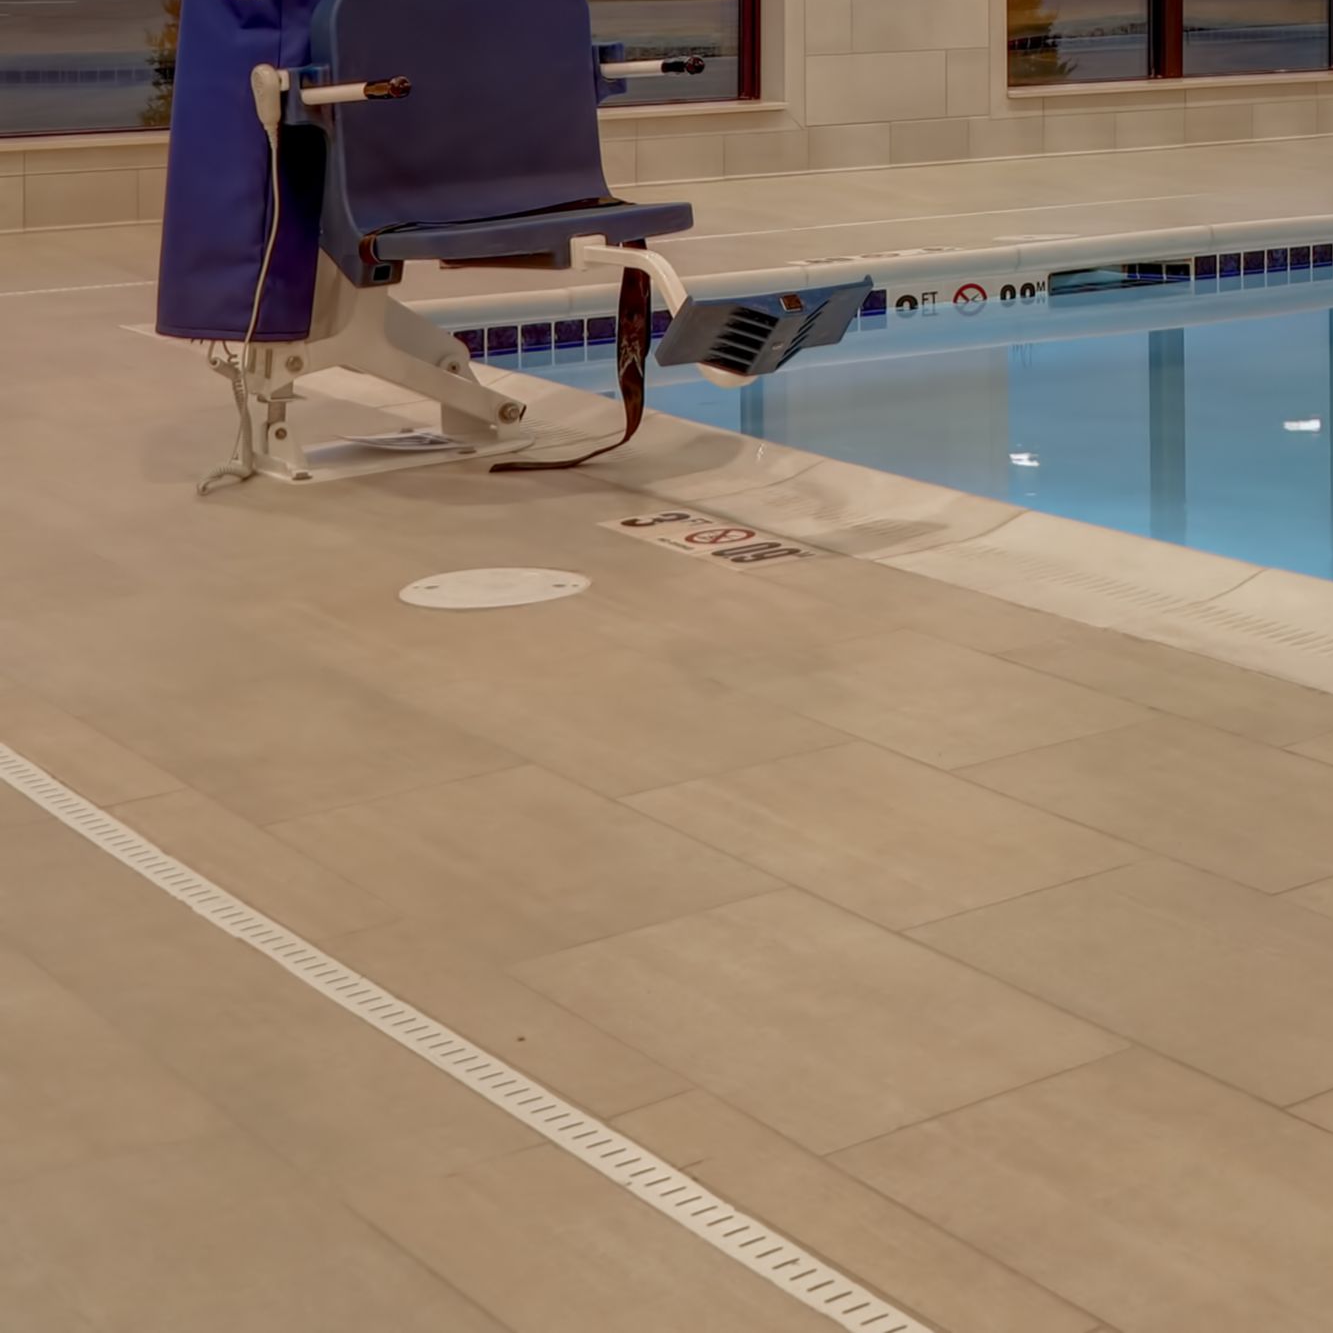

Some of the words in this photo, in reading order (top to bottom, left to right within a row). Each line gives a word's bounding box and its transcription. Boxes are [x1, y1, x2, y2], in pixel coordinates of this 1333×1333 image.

[1036, 281, 1045, 292] M
[921, 291, 938, 306] FT
[620, 512, 691, 527] 3
